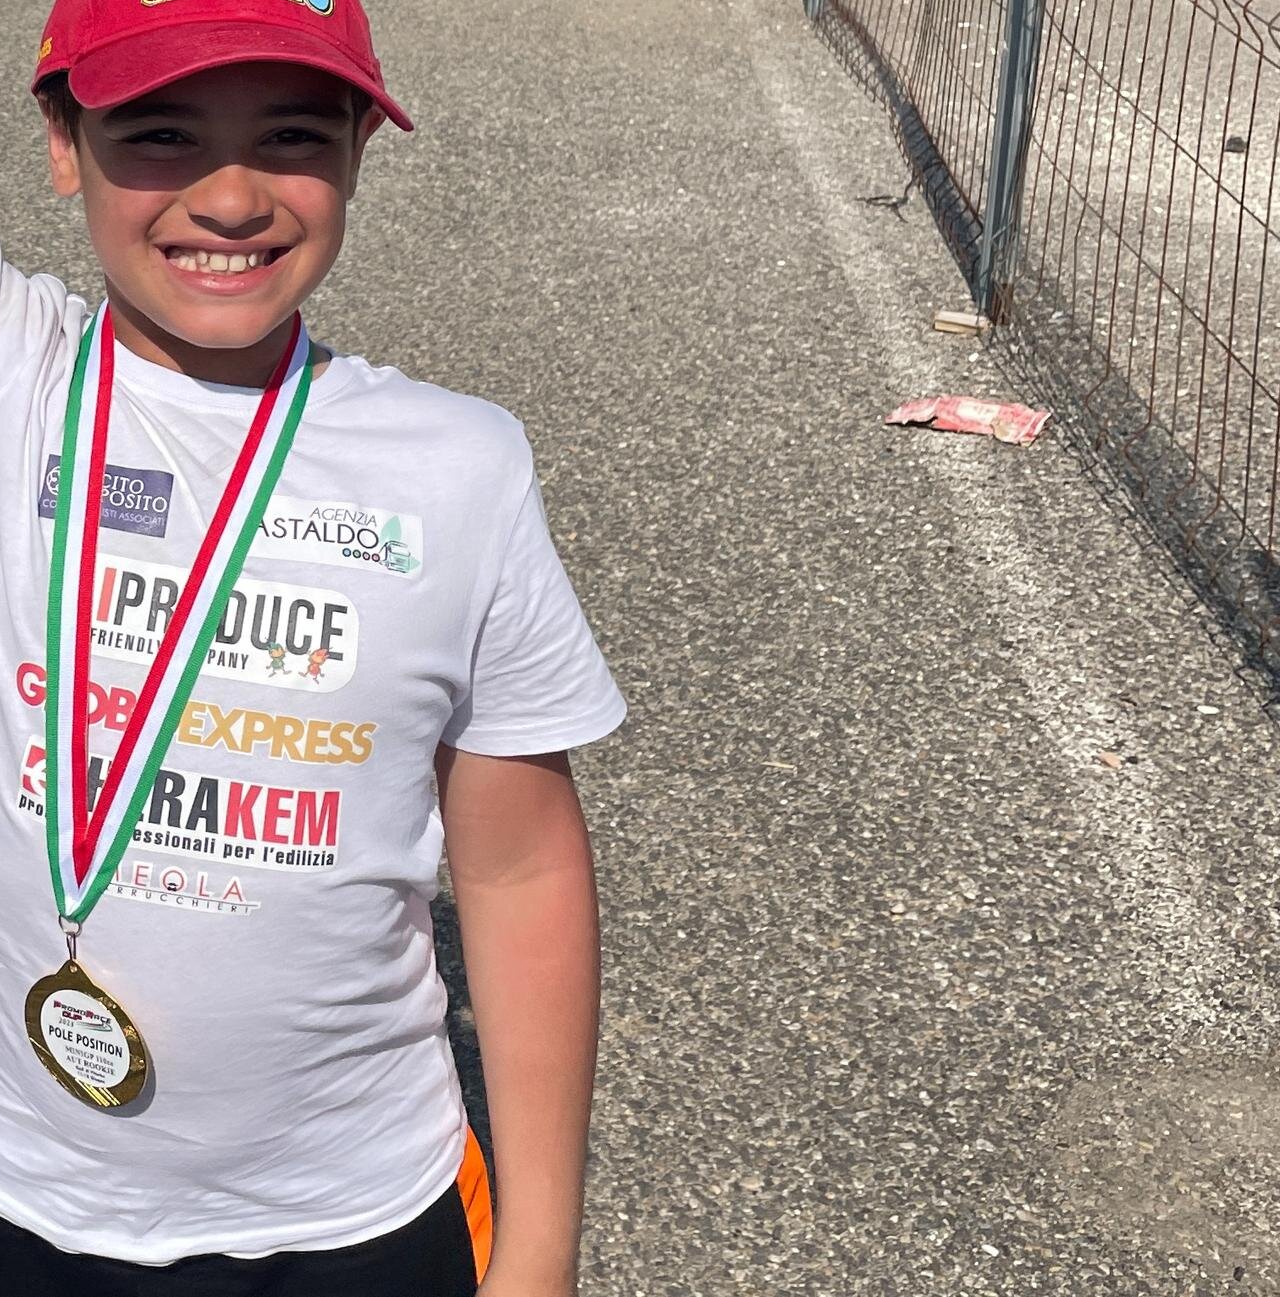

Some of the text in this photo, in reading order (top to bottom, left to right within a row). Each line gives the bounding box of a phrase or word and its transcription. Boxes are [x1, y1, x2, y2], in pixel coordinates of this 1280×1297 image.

[103, 473, 145, 495] CITO
[101, 489, 168, 513] POSITO
[310, 507, 377, 527] AGENZIA
[258, 516, 379, 549] ASTALDO
[96, 567, 348, 661] IPRDUCE
[207, 648, 249, 670] PANY
[17, 662, 378, 765] GOB EXPRESS
[133, 827, 216, 855] essionali
[223, 842, 254, 862] per
[263, 846, 335, 867] l'edilizia
[116, 886, 249, 914] RRUCCHIERI
[49, 1024, 123, 1058] POLE POSITION
[83, 1059, 116, 1075] ROOKIE
